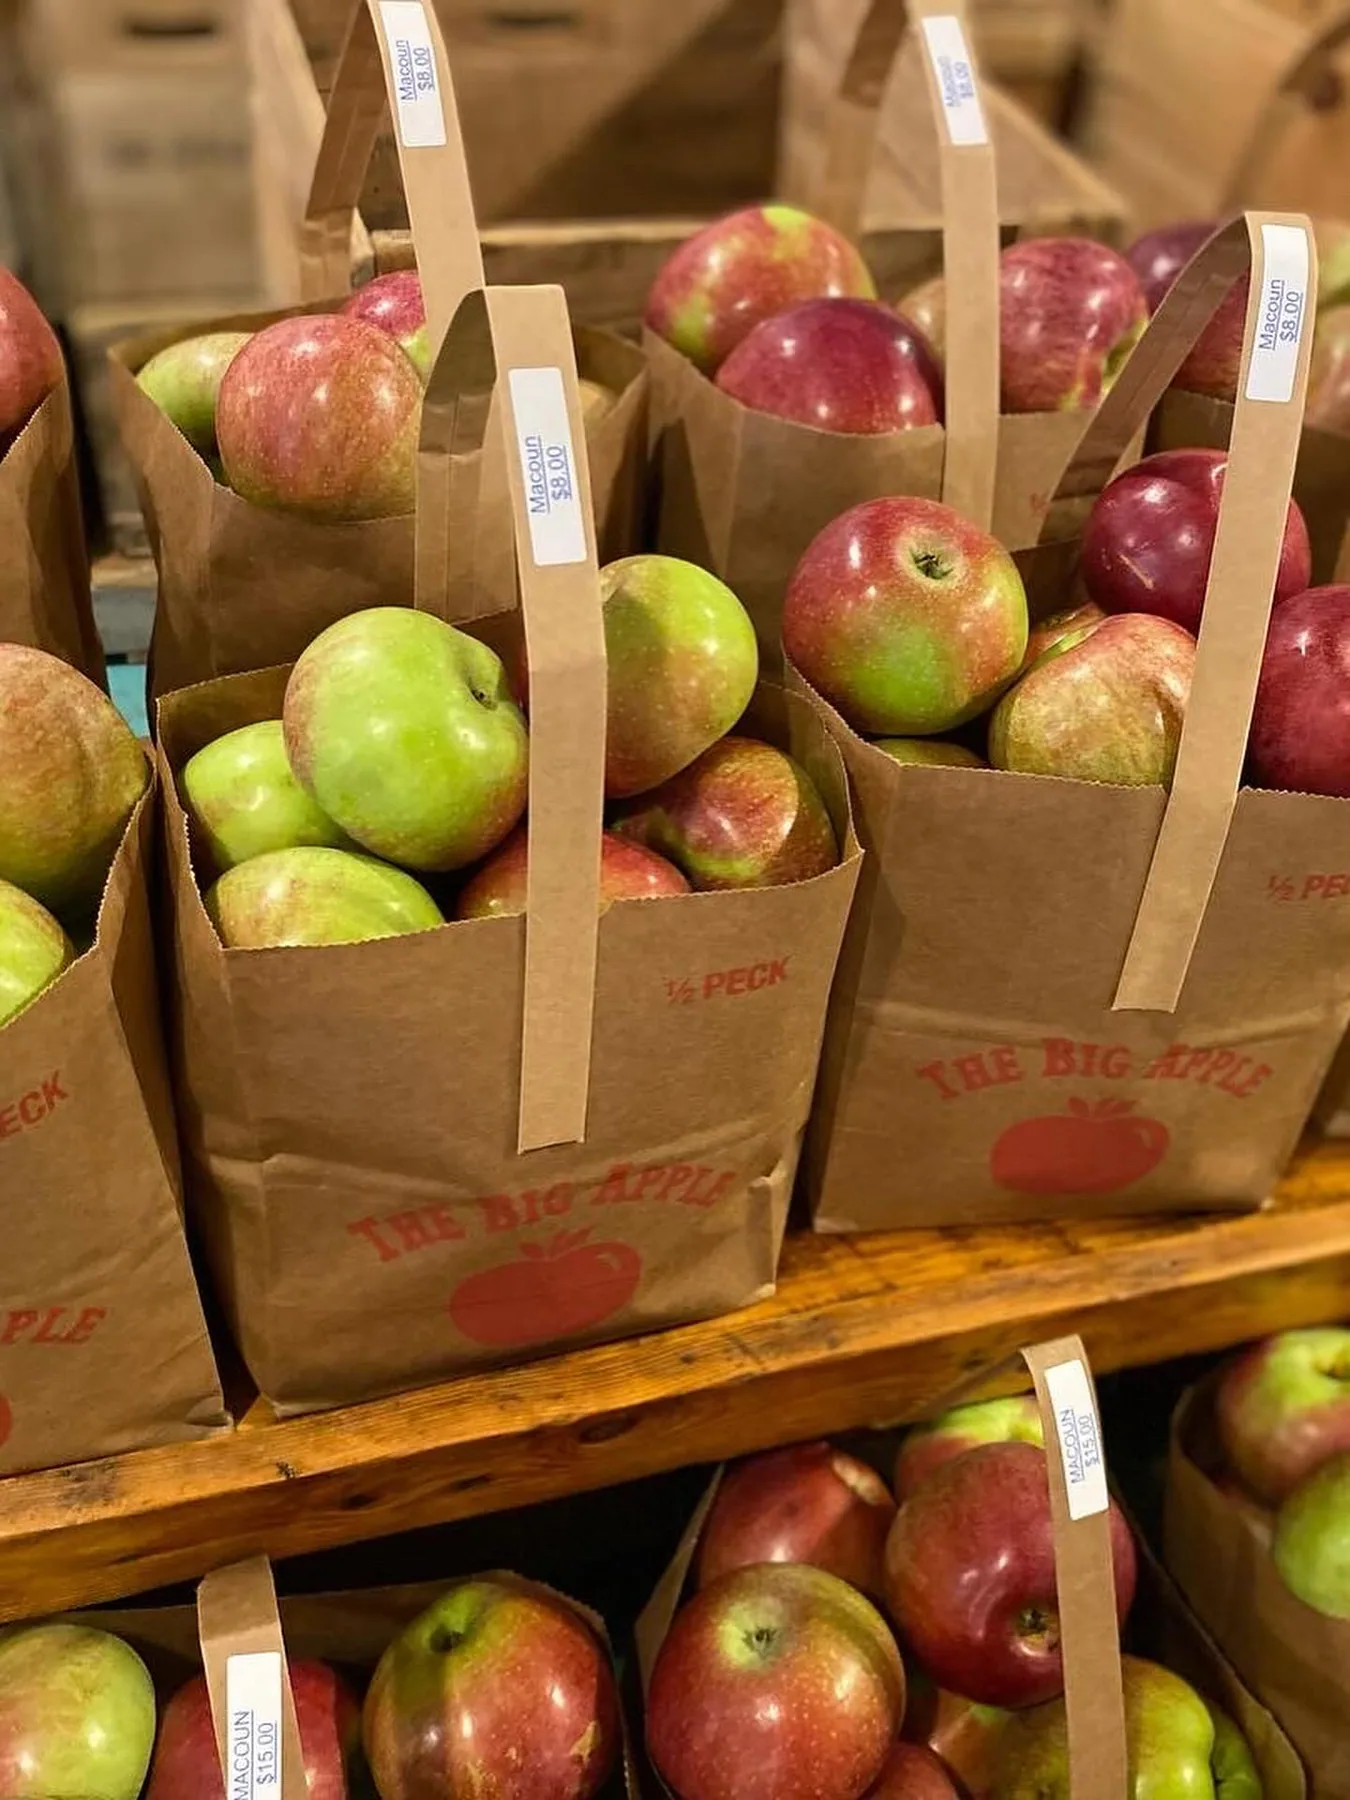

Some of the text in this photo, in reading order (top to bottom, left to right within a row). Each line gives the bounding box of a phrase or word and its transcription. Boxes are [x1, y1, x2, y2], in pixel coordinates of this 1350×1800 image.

[396, 40, 416, 102] Macoun
[413, 47, 433, 91] $8.00
[1258, 279, 1283, 350] Macoun
[1280, 291, 1301, 343] $8.00
[525, 435, 548, 514] Macoun
[546, 446, 570, 501] $8.00
[702, 956, 792, 1000] PECK
[915, 1037, 1274, 1100] THE BIG APPLE
[0, 1070, 69, 1137] ECK
[346, 1162, 737, 1262] THE BIG APPLE
[0, 1306, 107, 1345] PLE
[1060, 1409, 1083, 1485] MACOUN
[1077, 1414, 1099, 1468] $15.00
[233, 1710, 251, 1800] MACOUN
[256, 1722, 275, 1786] $15.00
